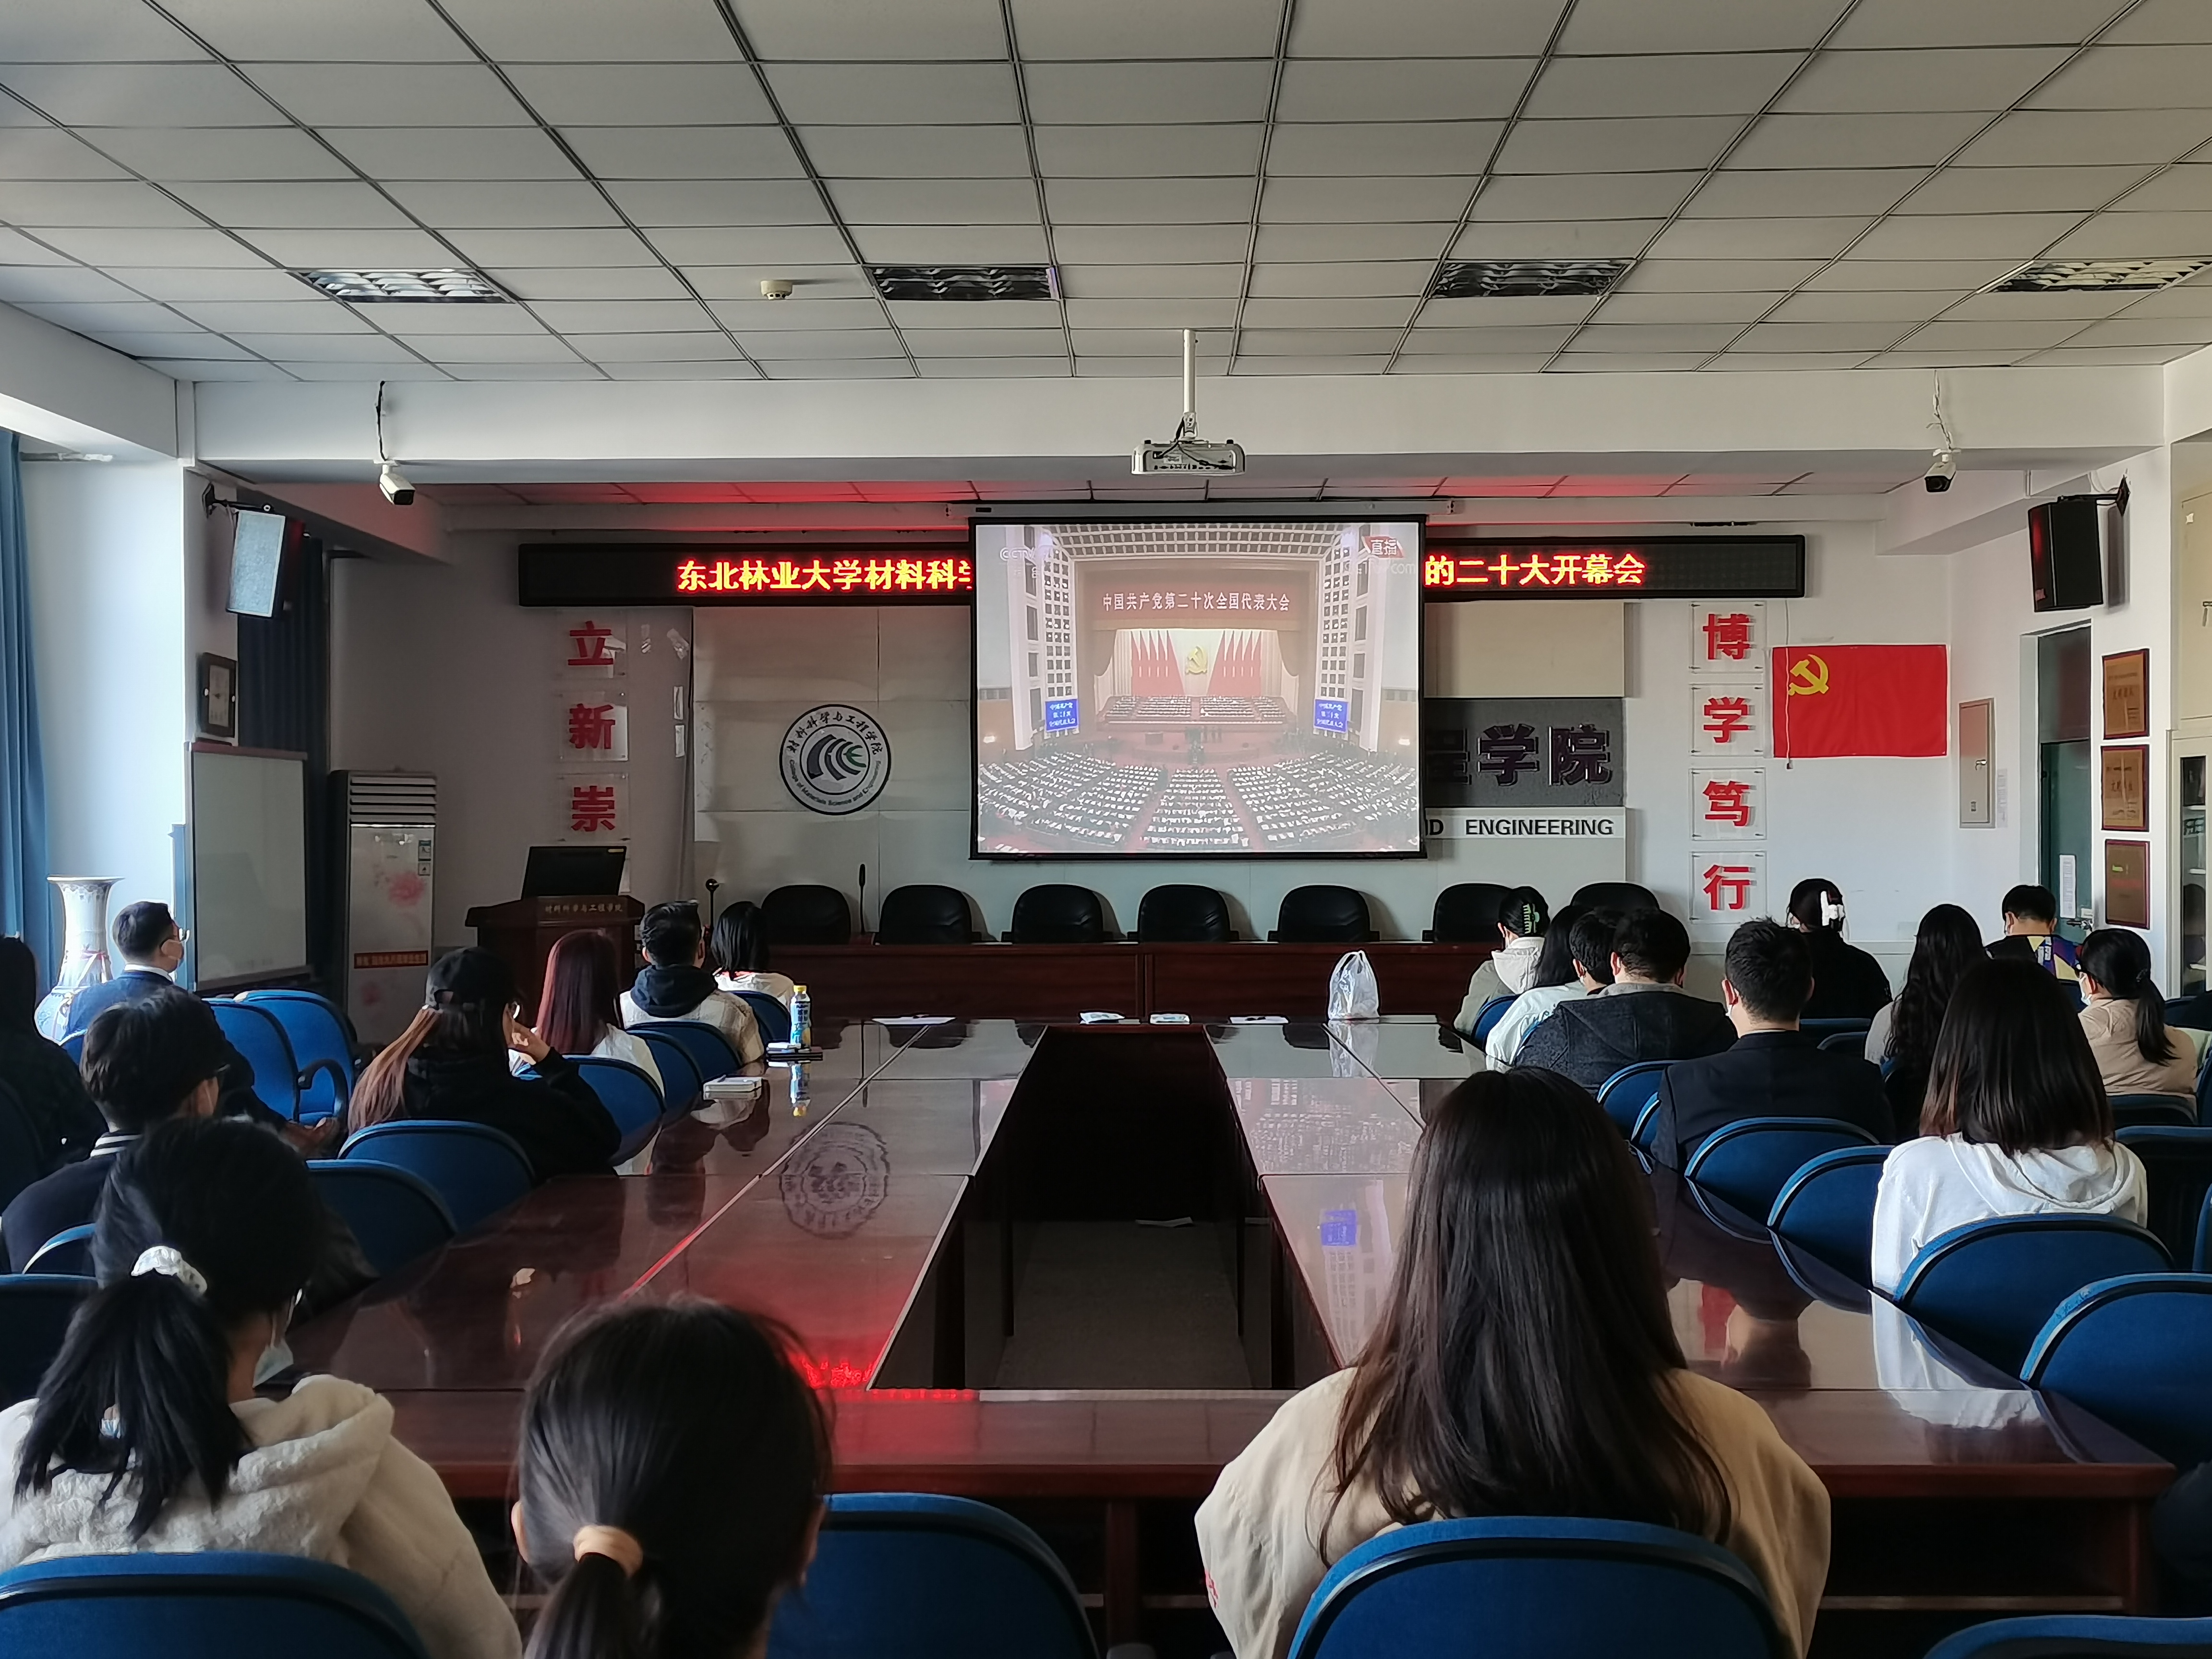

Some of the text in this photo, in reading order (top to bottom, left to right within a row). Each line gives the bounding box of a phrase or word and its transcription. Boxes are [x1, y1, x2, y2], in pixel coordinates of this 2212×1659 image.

[999, 547, 1035, 561] CCTV
[1370, 539, 1397, 555] 直播
[1424, 553, 1645, 585] 的二十大开幕会
[1103, 592, 1290, 611] 中国共产党第二十次全国代表大会
[1466, 819, 1614, 836] ENGINEERING
